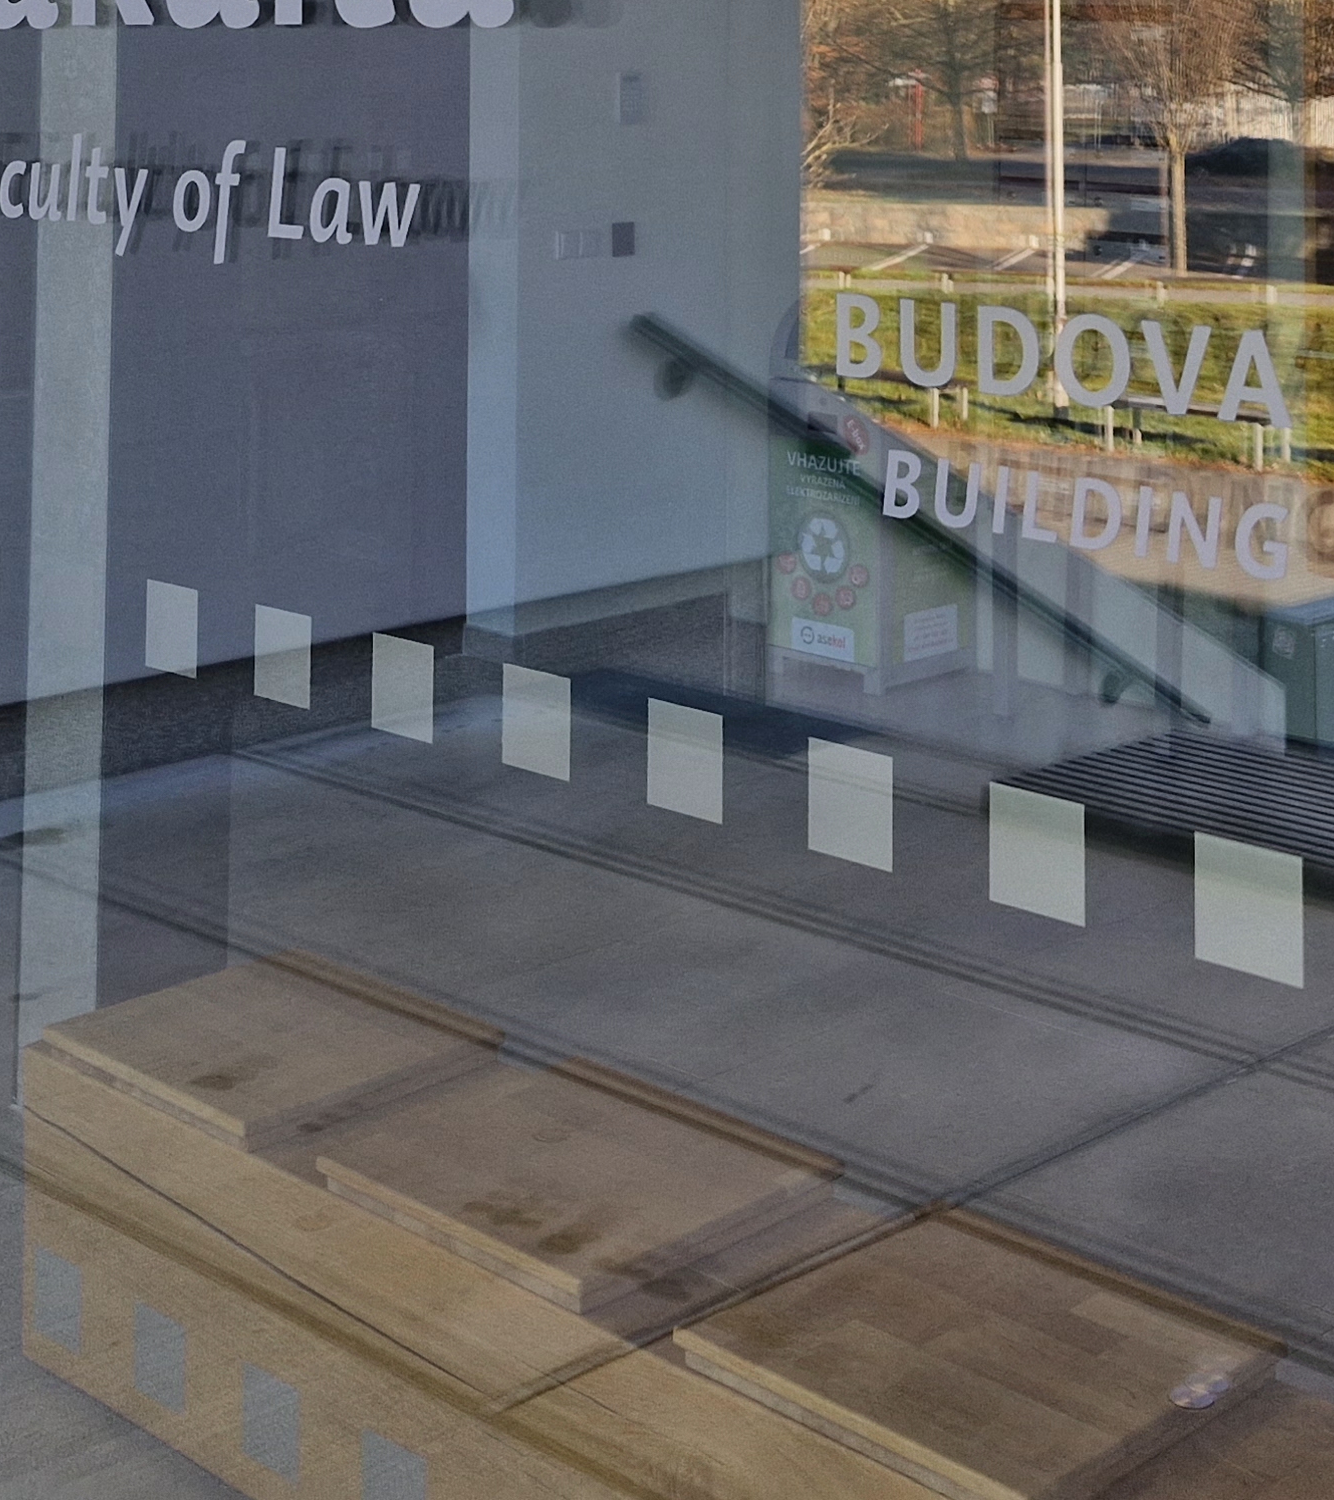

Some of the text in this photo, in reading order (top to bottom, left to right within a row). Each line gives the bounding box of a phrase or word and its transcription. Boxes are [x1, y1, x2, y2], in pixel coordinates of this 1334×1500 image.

[173, 139, 247, 264] of
[267, 144, 420, 248] Law
[834, 292, 1293, 429] BUDOVA
[786, 450, 861, 477] VHAZUJTE
[881, 448, 1291, 581] BUILDING
